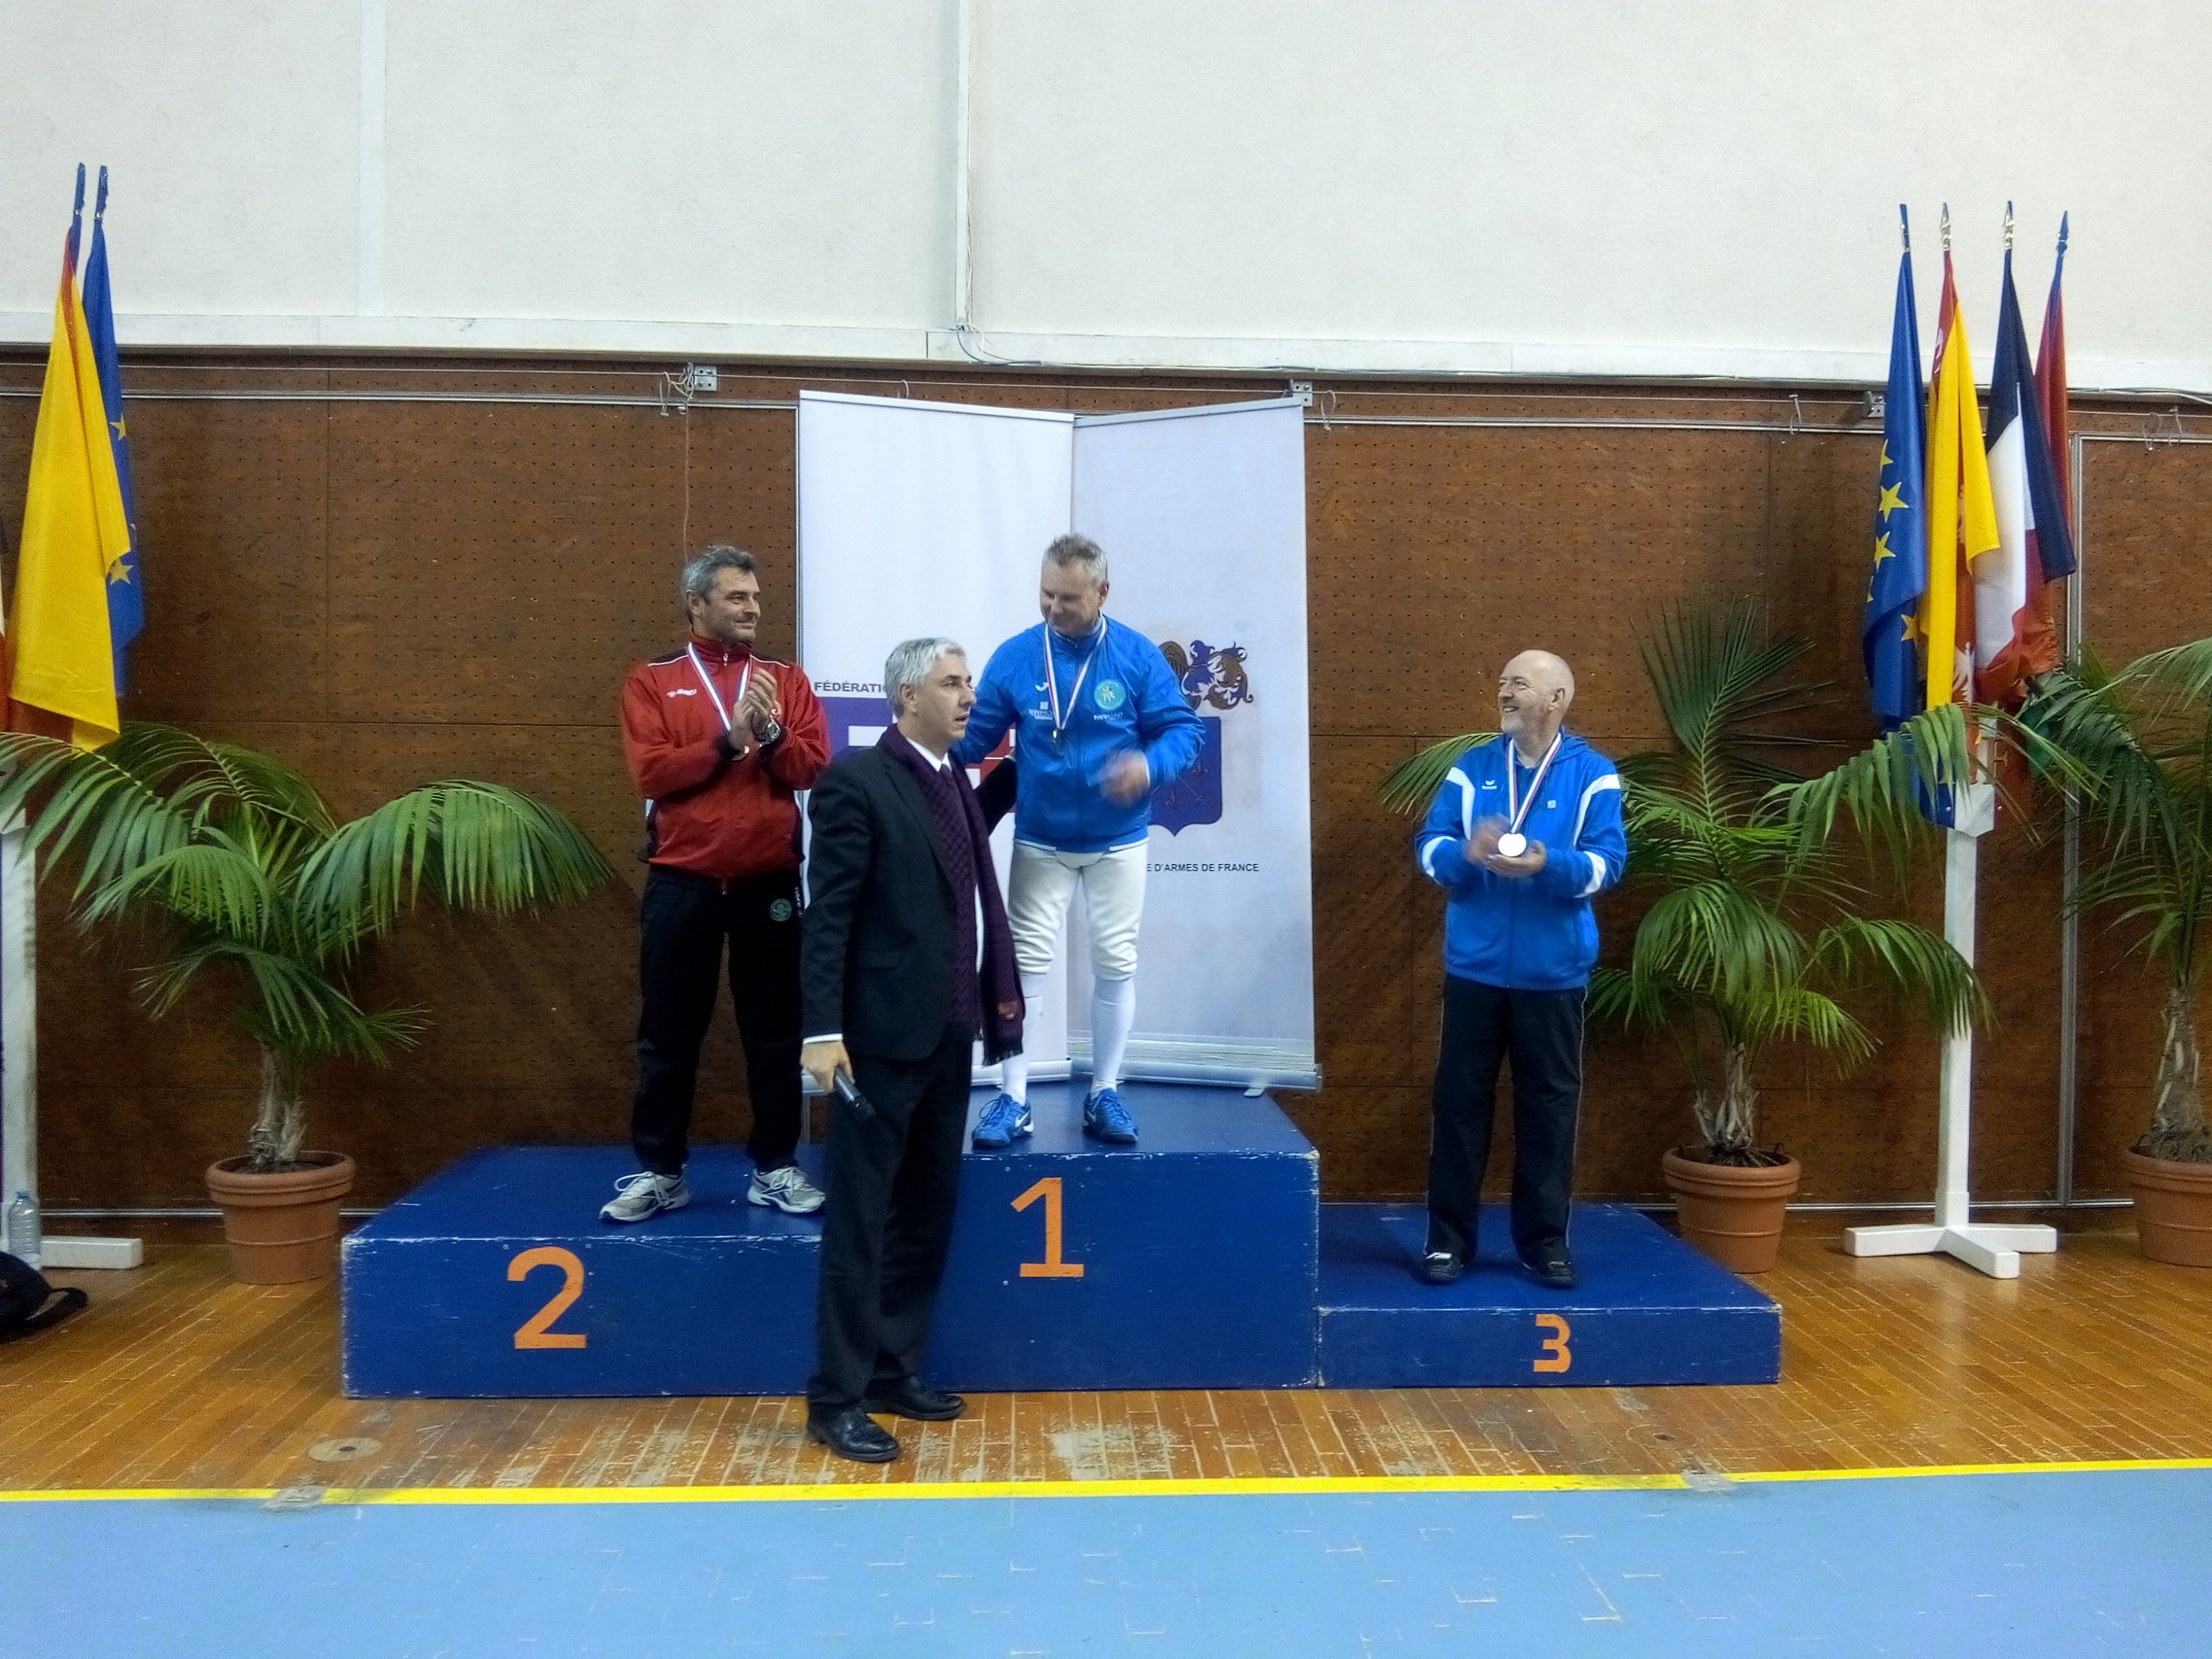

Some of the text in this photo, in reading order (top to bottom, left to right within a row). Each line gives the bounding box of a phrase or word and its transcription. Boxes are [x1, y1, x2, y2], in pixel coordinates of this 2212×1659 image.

[814, 680, 884, 693] FÉDÉRATI
[1154, 863, 1198, 872] D'ARMES
[1202, 863, 1214, 872] DE
[1218, 863, 1259, 872] FRANCE
[1010, 1177, 1084, 1277] 1
[507, 1246, 587, 1349] 2
[1533, 1313, 1572, 1373] 3
